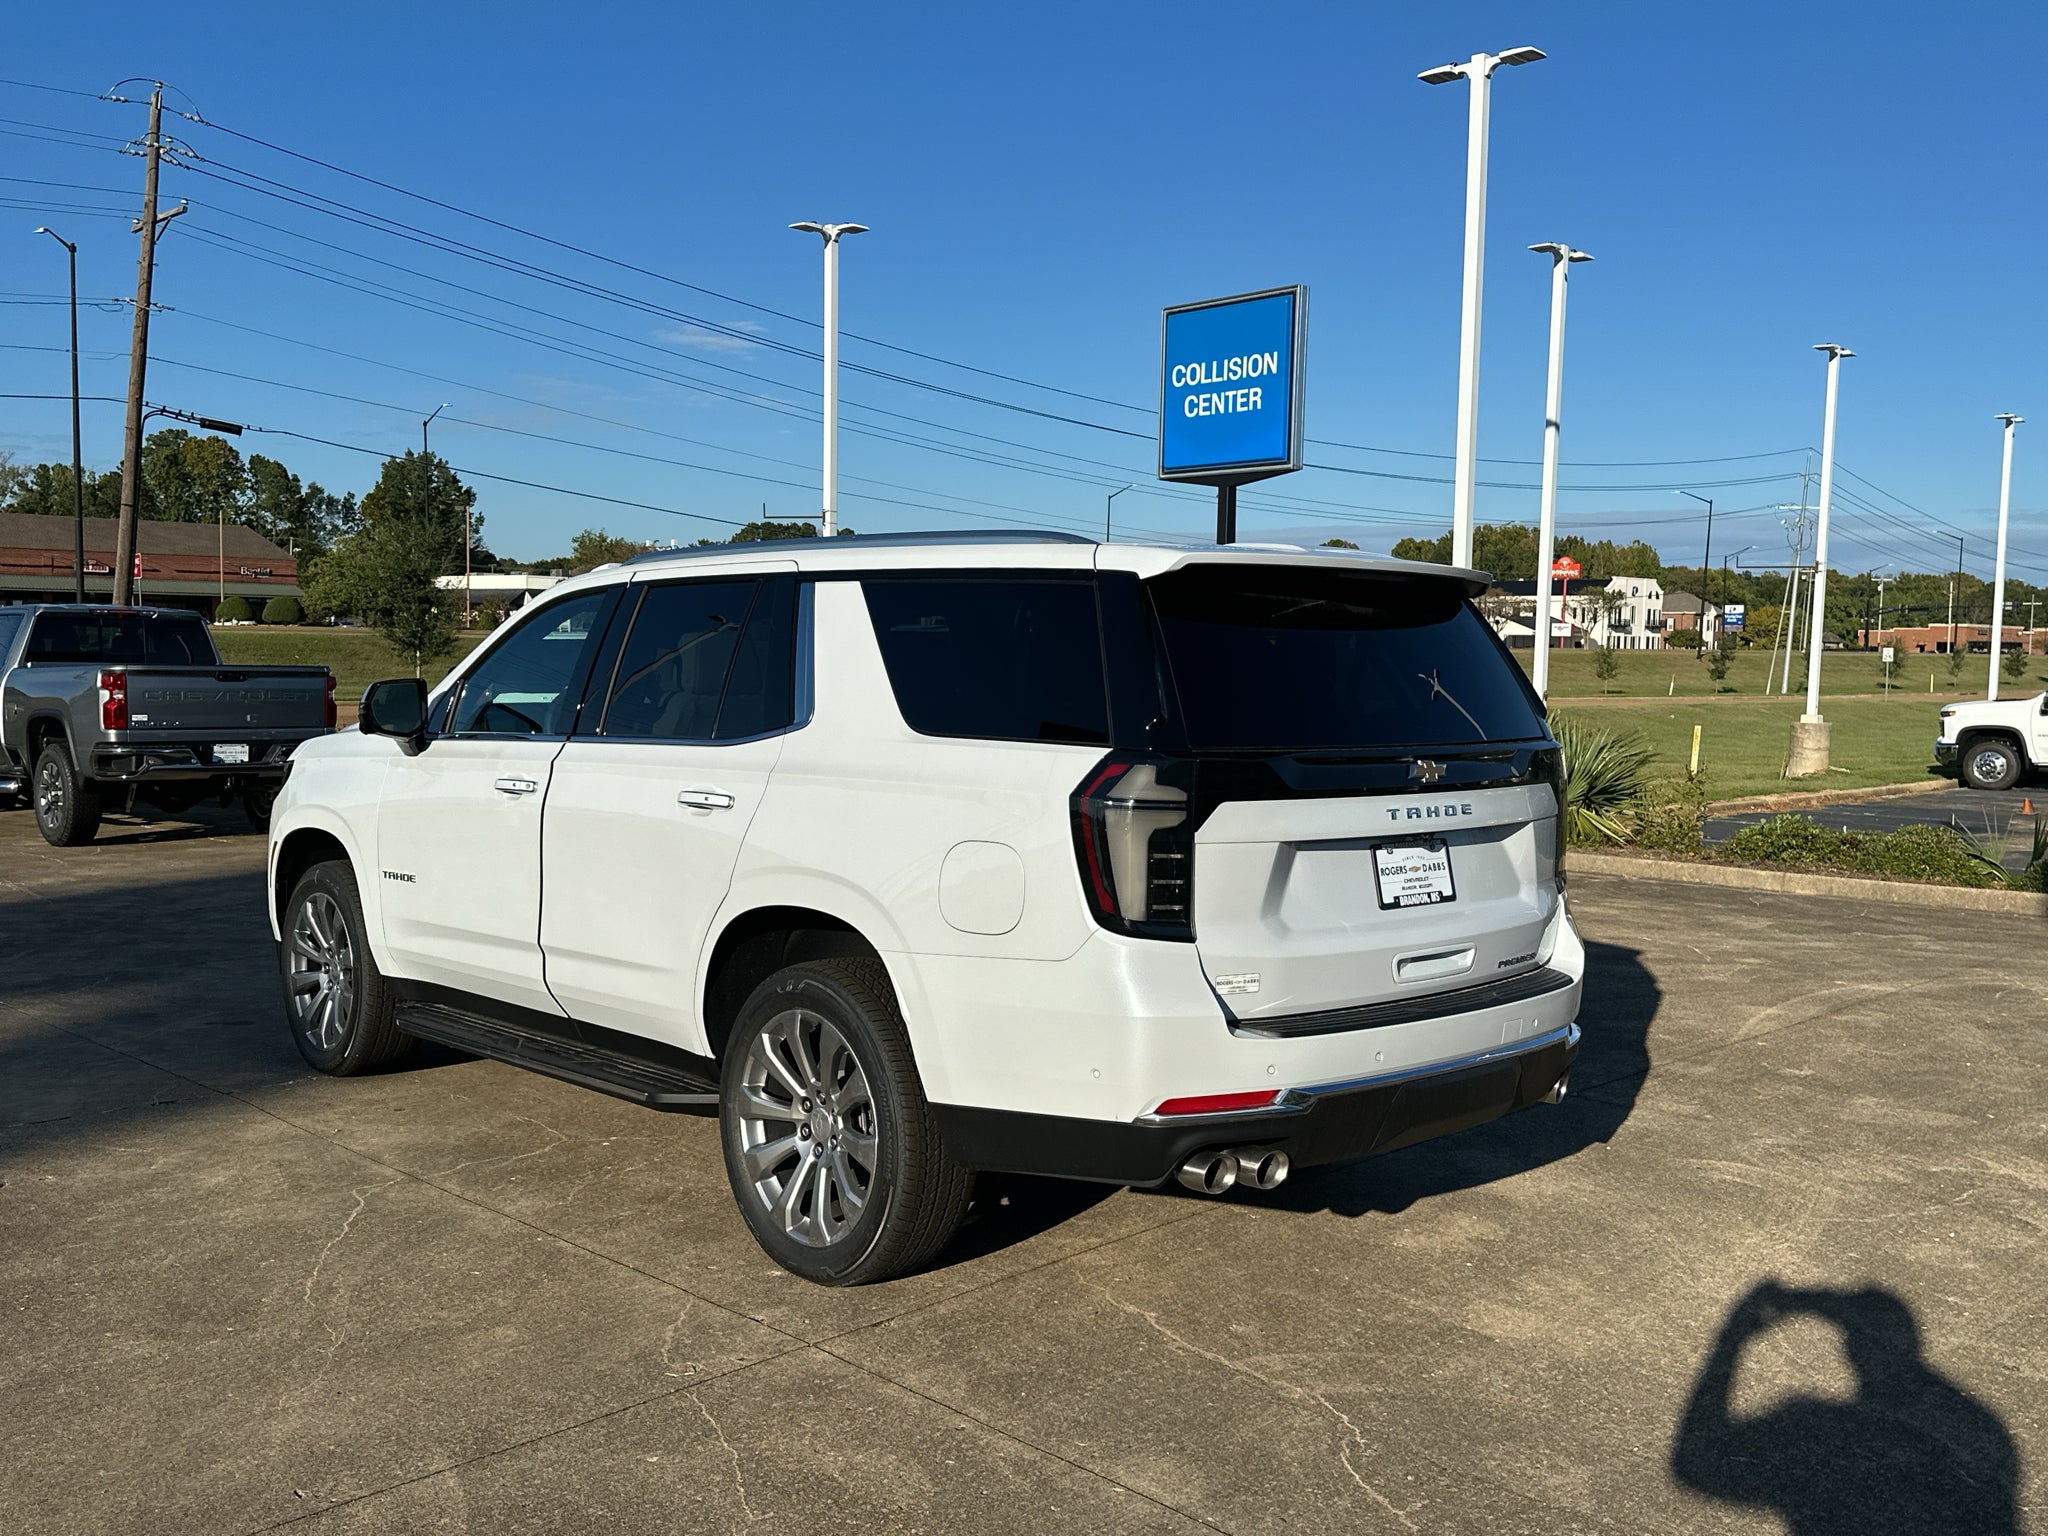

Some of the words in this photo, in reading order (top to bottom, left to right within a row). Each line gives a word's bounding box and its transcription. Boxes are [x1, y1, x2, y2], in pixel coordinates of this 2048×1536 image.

[1172, 351, 1279, 388] COLLISION
[1184, 387, 1263, 418] CENTER
[1386, 803, 1473, 821] TAHOE
[382, 870, 417, 884] TAHOE
[1380, 865, 1408, 877] ROGERS
[1422, 861, 1446, 873] DABBS
[1403, 876, 1429, 884] CHEVROLET
[1399, 893, 1430, 906] BRANDON,
[1430, 891, 1440, 903] MS
